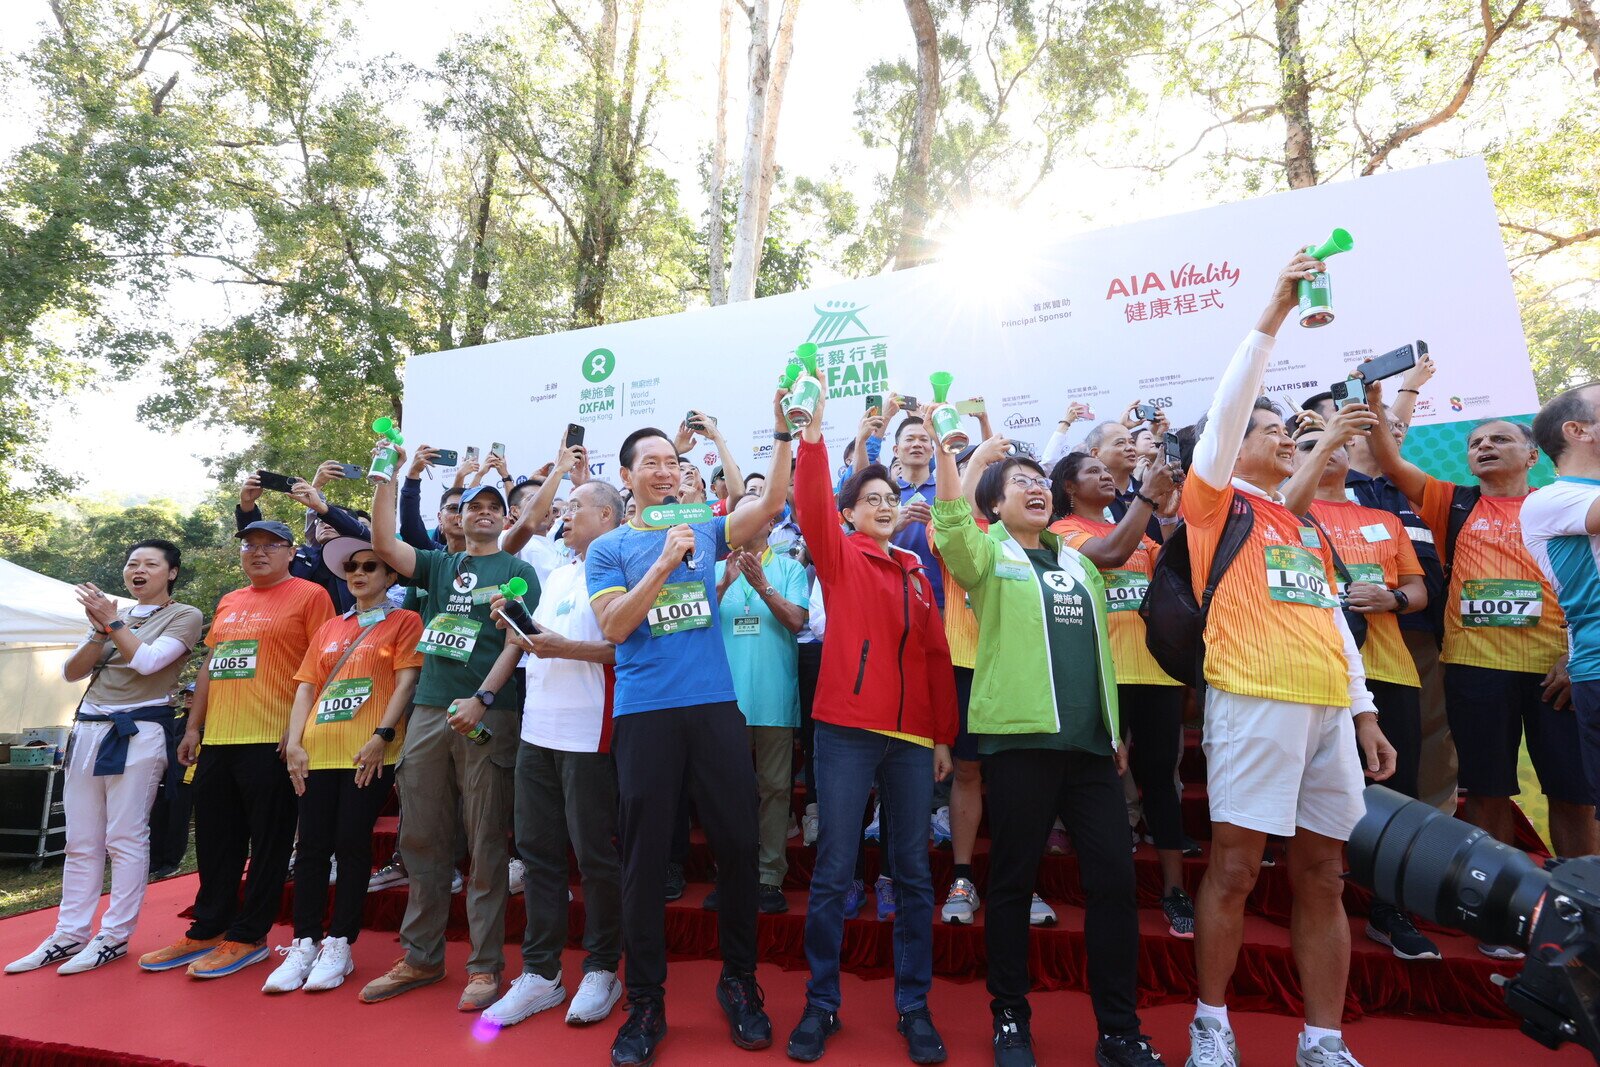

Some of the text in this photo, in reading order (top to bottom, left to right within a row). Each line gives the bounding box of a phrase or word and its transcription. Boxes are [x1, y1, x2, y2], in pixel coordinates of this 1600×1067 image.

[1106, 261, 1240, 300] AIA Vitality
[1124, 289, 1224, 323] 健康程式
[1001, 311, 1072, 328] Principal Sponsor
[821, 360, 889, 387] FAM
[580, 384, 616, 400] 樂施會
[825, 381, 890, 400] WALKER
[1267, 382, 1301, 393] VIATRIS
[530, 392, 558, 402] Organiser
[630, 391, 650, 399] World
[579, 399, 615, 414] OXFAM
[630, 398, 656, 408] Without
[1148, 397, 1173, 408] SGS
[579, 413, 613, 423] Hong Kong
[629, 407, 656, 416] Poverty
[1009, 416, 1041, 426] LAPUTA
[1279, 570, 1326, 598] L002
[1053, 594, 1083, 606] 樂施會
[446, 604, 472, 613] OXFAM
[656, 602, 703, 623] L001
[1053, 605, 1083, 617] OXFAM
[1469, 600, 1530, 615] L007
[1055, 616, 1083, 625] Hong Kong
[426, 630, 468, 650] L006
[213, 657, 248, 670] L065
[323, 696, 363, 713] L003
[1471, 869, 1487, 882] G
